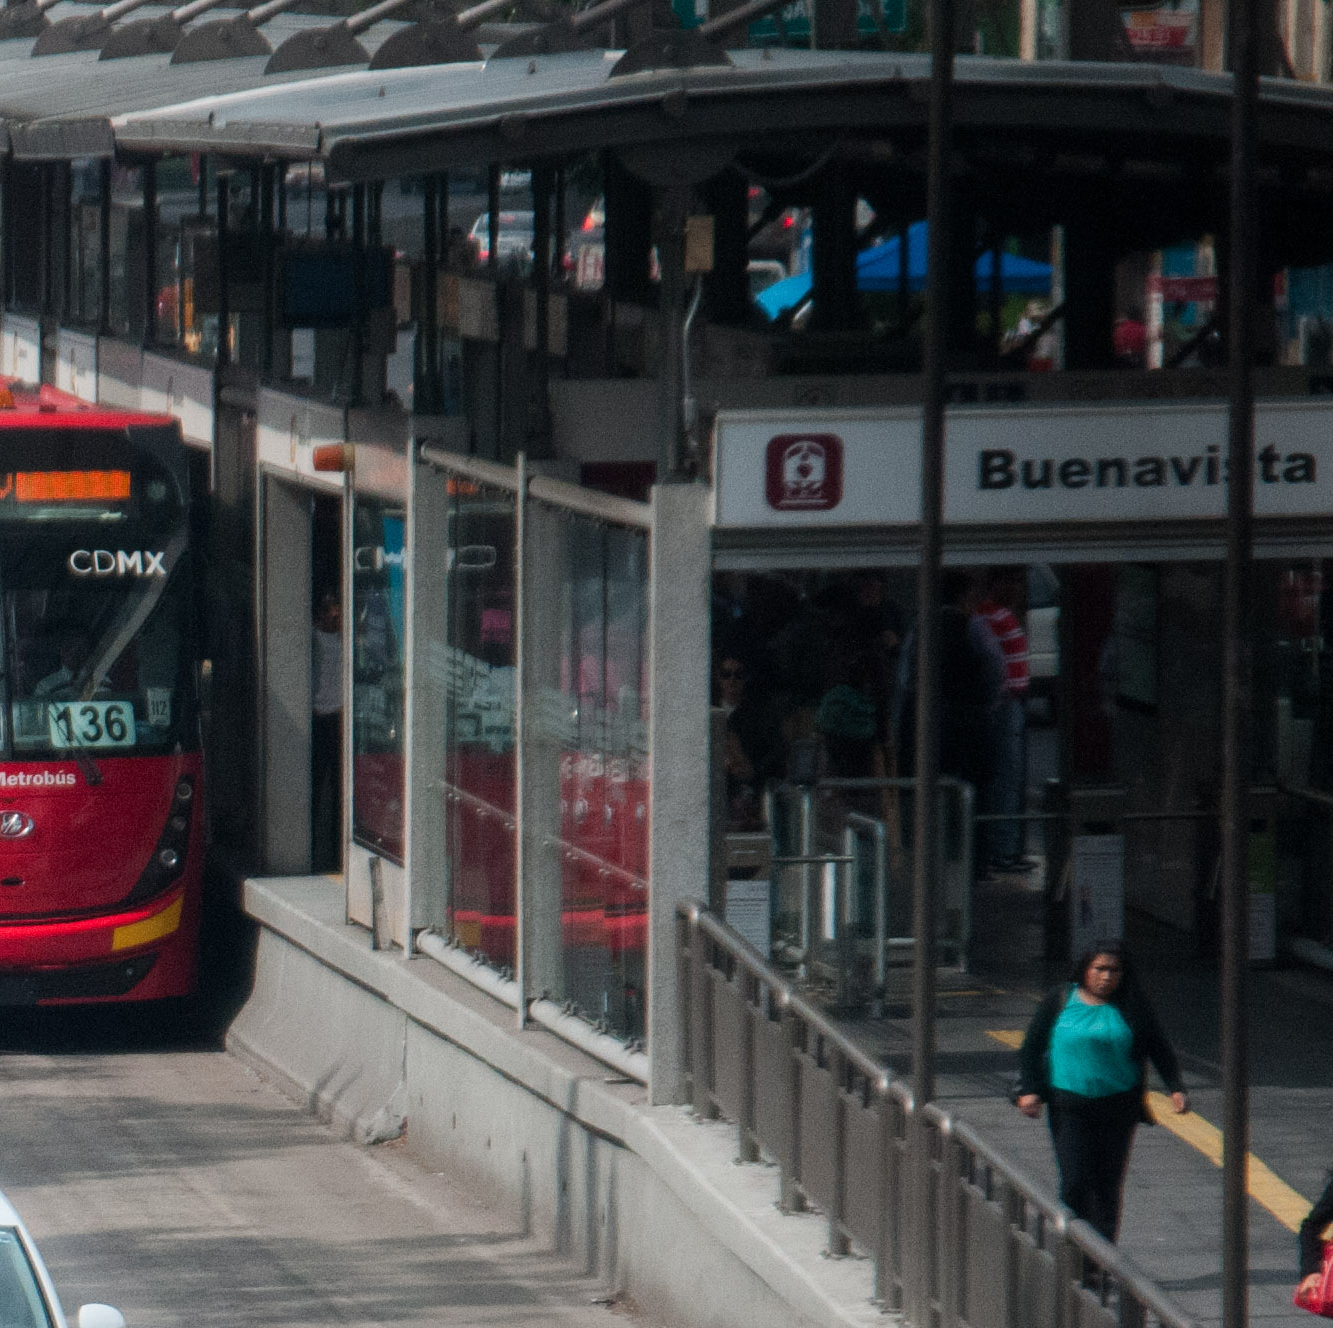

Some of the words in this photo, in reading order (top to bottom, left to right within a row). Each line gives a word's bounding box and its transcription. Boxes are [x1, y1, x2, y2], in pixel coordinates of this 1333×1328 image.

[979, 445, 1317, 490] Buenavita
[70, 550, 166, 575] CDMX
[57, 704, 128, 742] 136
